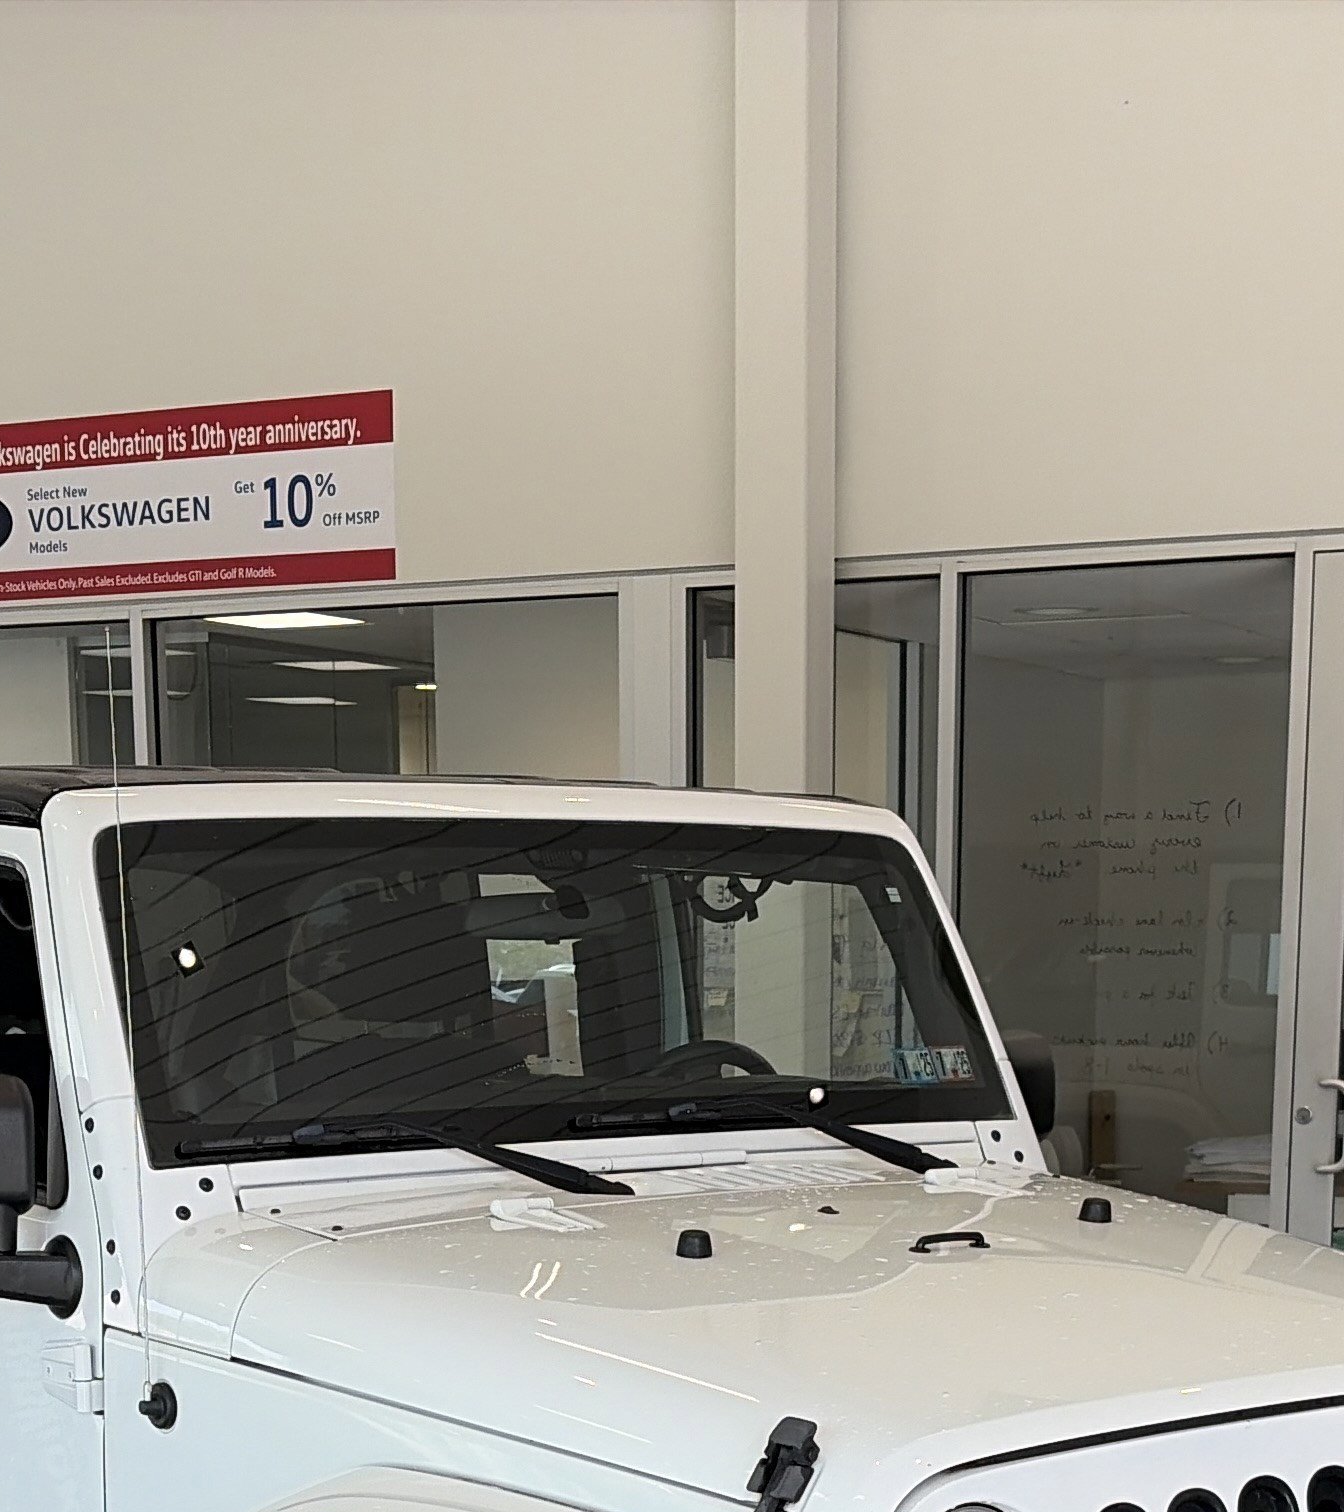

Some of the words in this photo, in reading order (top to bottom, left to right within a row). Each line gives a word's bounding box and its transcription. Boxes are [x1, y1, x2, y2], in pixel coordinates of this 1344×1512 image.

[62, 435, 77, 461] is
[79, 428, 164, 460] Celebrating
[167, 425, 187, 452] it's
[190, 421, 226, 451] 10th
[229, 424, 262, 455] year
[265, 414, 361, 445] anniversary.
[26, 487, 60, 502] Select
[62, 485, 88, 499] New
[234, 481, 255, 494] Get
[263, 472, 337, 529] 10%
[27, 495, 211, 533] VOLKSWAGEN
[322, 512, 342, 527] Off
[345, 510, 380, 526] MSRP
[28, 540, 68, 554] Models
[25, 579, 57, 592] Vehicles
[77, 576, 94, 589] Past
[95, 575, 115, 588] Sales
[153, 571, 188, 584] Excludes
[203, 568, 218, 581] and
[219, 566, 237, 580] Golf
[238, 567, 245, 579] R
[245, 565, 277, 578] Models.
